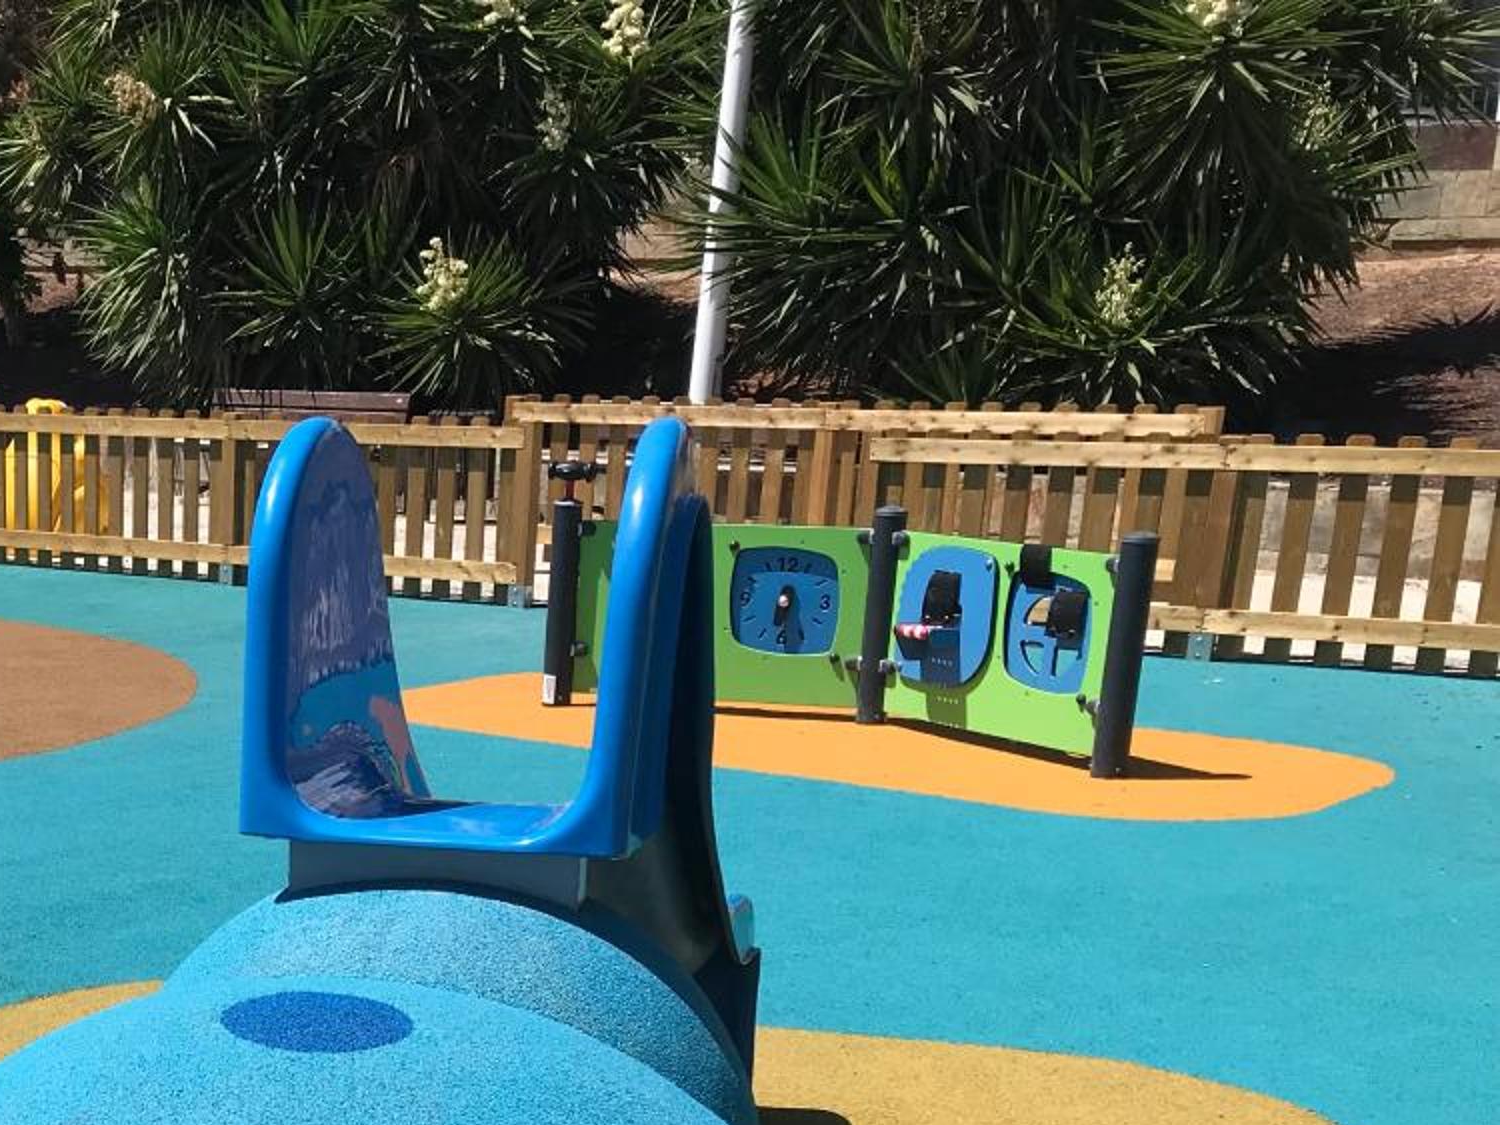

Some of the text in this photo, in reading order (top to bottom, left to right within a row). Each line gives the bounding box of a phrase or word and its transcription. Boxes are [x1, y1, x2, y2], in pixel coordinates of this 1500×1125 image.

[777, 557, 799, 572] 12
[740, 591, 751, 607] 9
[820, 593, 831, 610] 3
